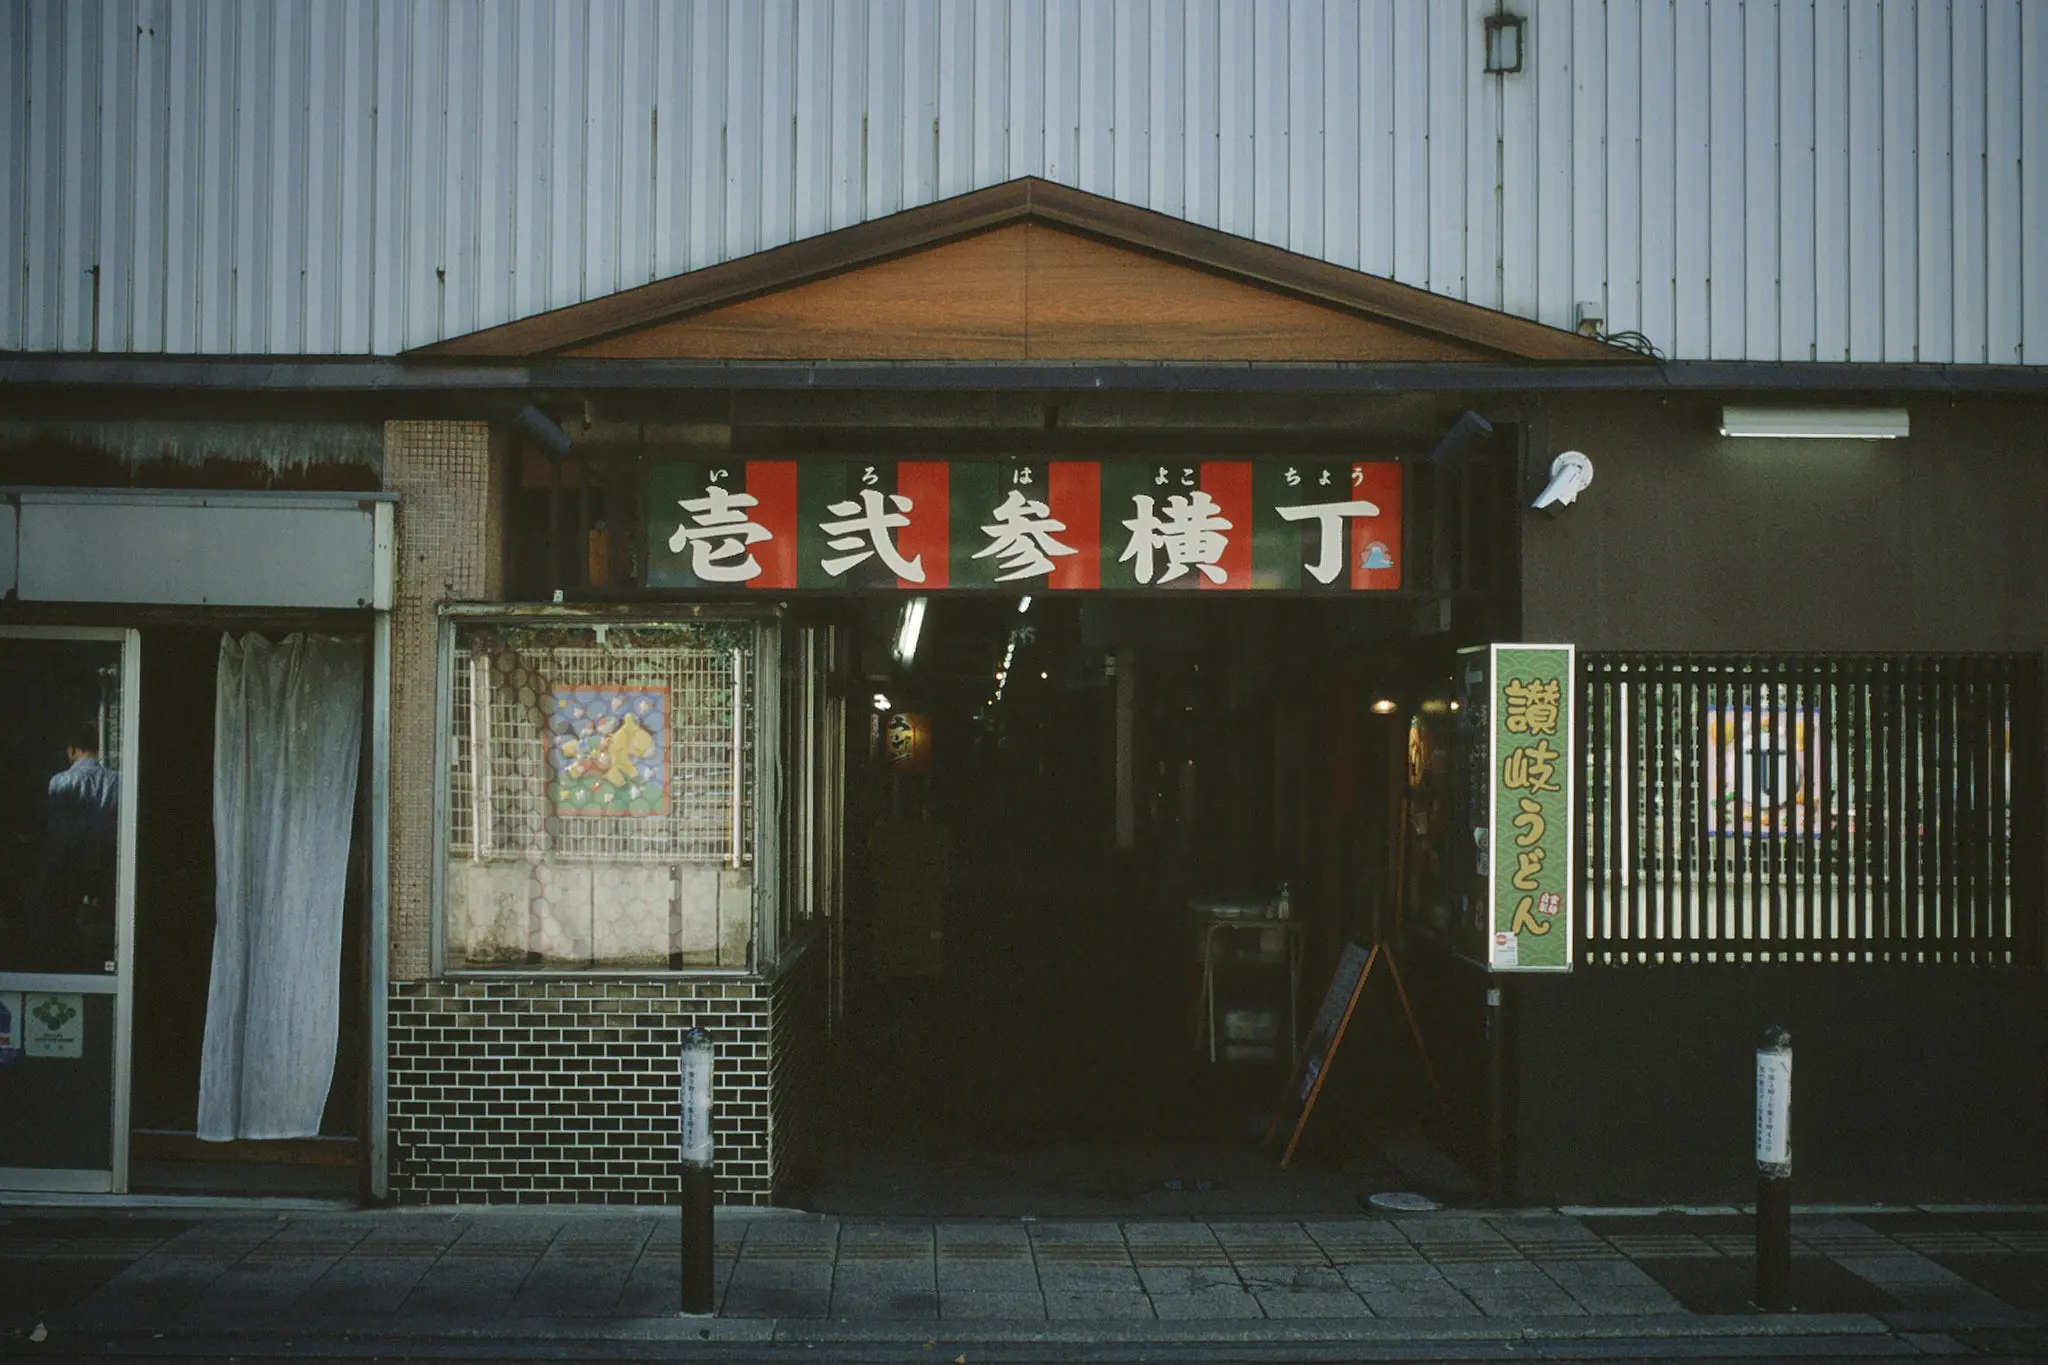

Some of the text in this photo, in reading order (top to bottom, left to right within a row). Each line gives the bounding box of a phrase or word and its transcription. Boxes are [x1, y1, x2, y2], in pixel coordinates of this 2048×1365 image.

[668, 485, 1381, 585] 壱弐参横丁
